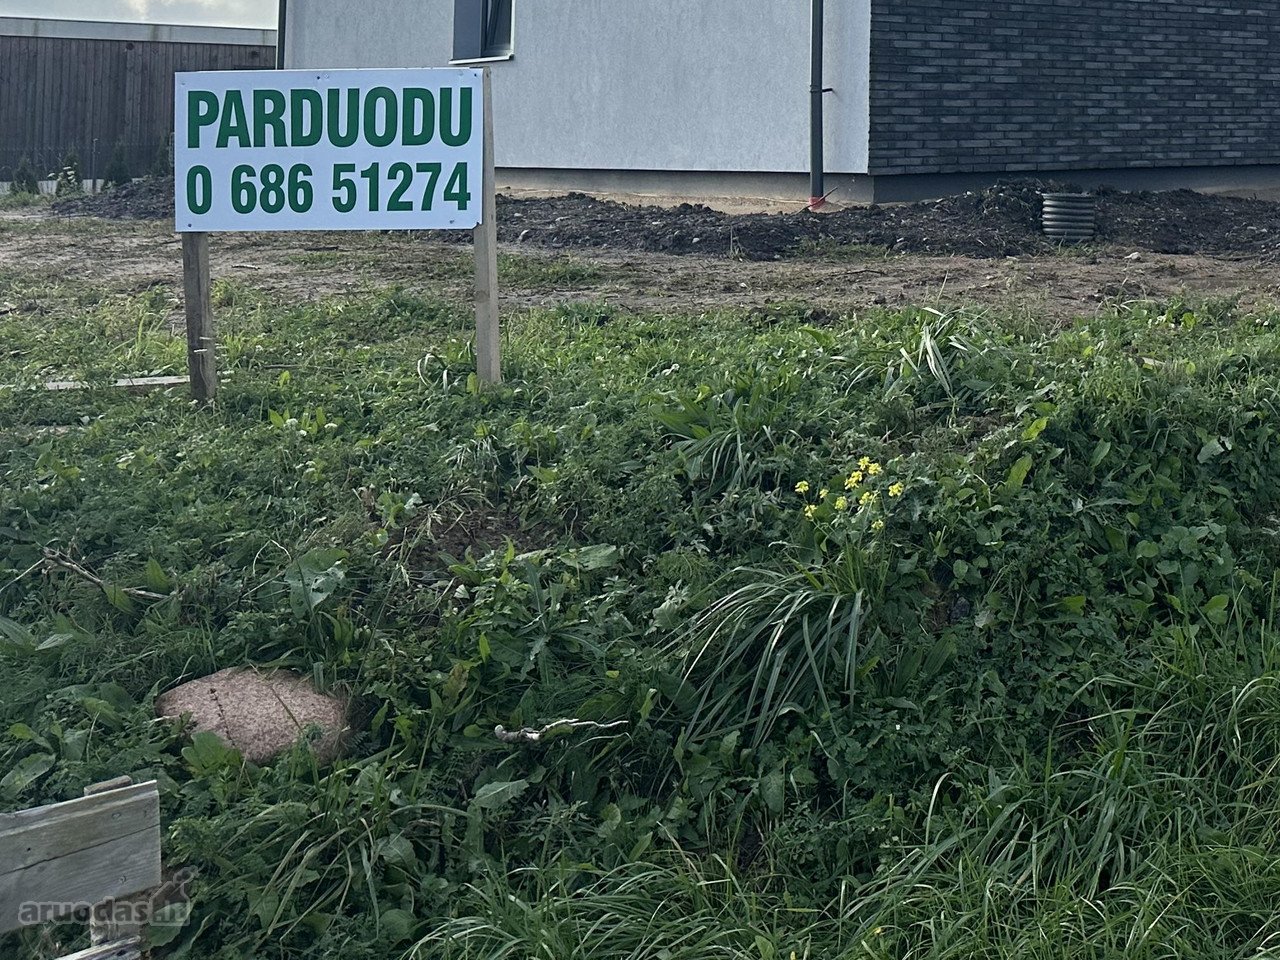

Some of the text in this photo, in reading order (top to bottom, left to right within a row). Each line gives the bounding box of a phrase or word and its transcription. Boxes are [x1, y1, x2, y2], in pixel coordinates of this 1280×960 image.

[187, 86, 473, 149] PARDUODU
[186, 161, 471, 215] 0 686 51274
